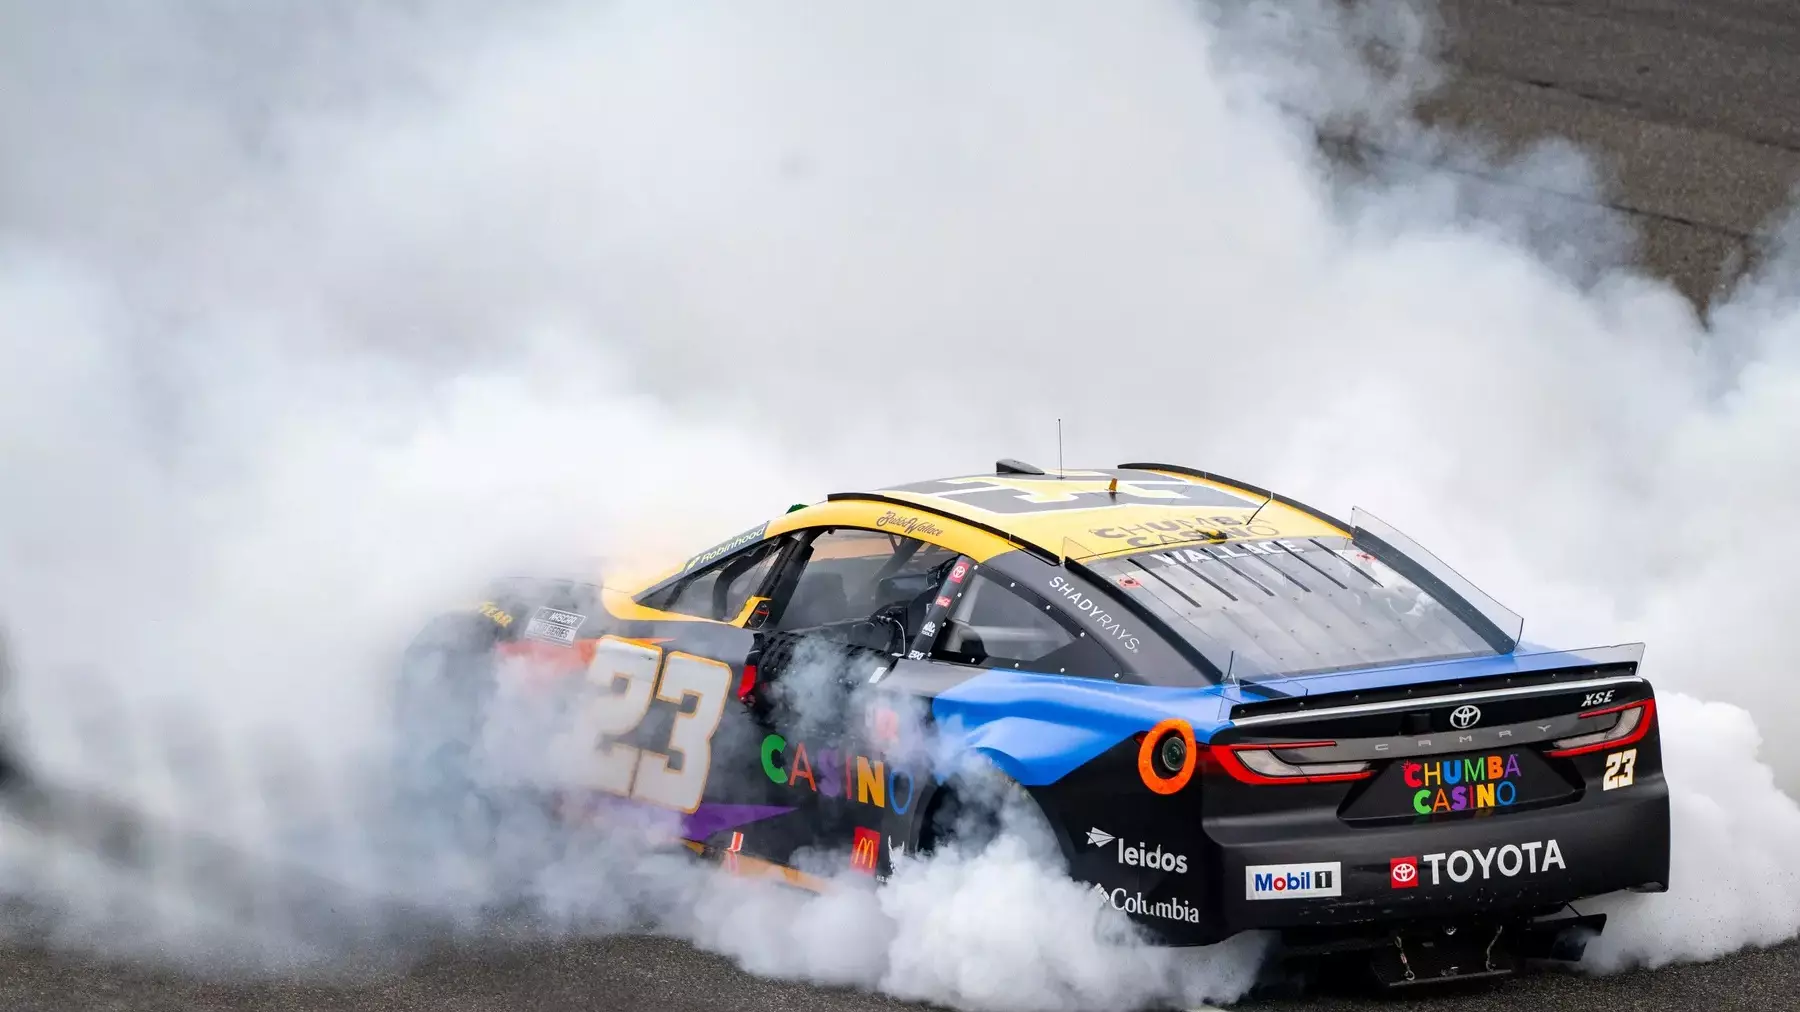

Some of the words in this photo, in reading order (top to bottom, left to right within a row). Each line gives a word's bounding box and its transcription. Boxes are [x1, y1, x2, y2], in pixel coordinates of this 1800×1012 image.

[1093, 514, 1271, 539] CHUMBA
[1127, 525, 1279, 548] CASNO
[701, 525, 766, 564] Robinhood
[1150, 540, 1304, 566] WALLACE
[548, 612, 578, 625] NASCAR
[1581, 690, 1615, 707] XSE
[580, 634, 732, 814] 23
[1374, 724, 1552, 751] CAMRY
[761, 734, 914, 815] CASINO
[1403, 754, 1522, 788] CHUMBA
[1603, 748, 1637, 791] 23
[1413, 780, 1516, 814] CASINO
[1118, 838, 1188, 873] leidos
[1424, 839, 1566, 885] TOYOTA
[1255, 871, 1311, 891] Mobil
[1318, 871, 1329, 888] 1
[1110, 887, 1200, 923] Columbia
